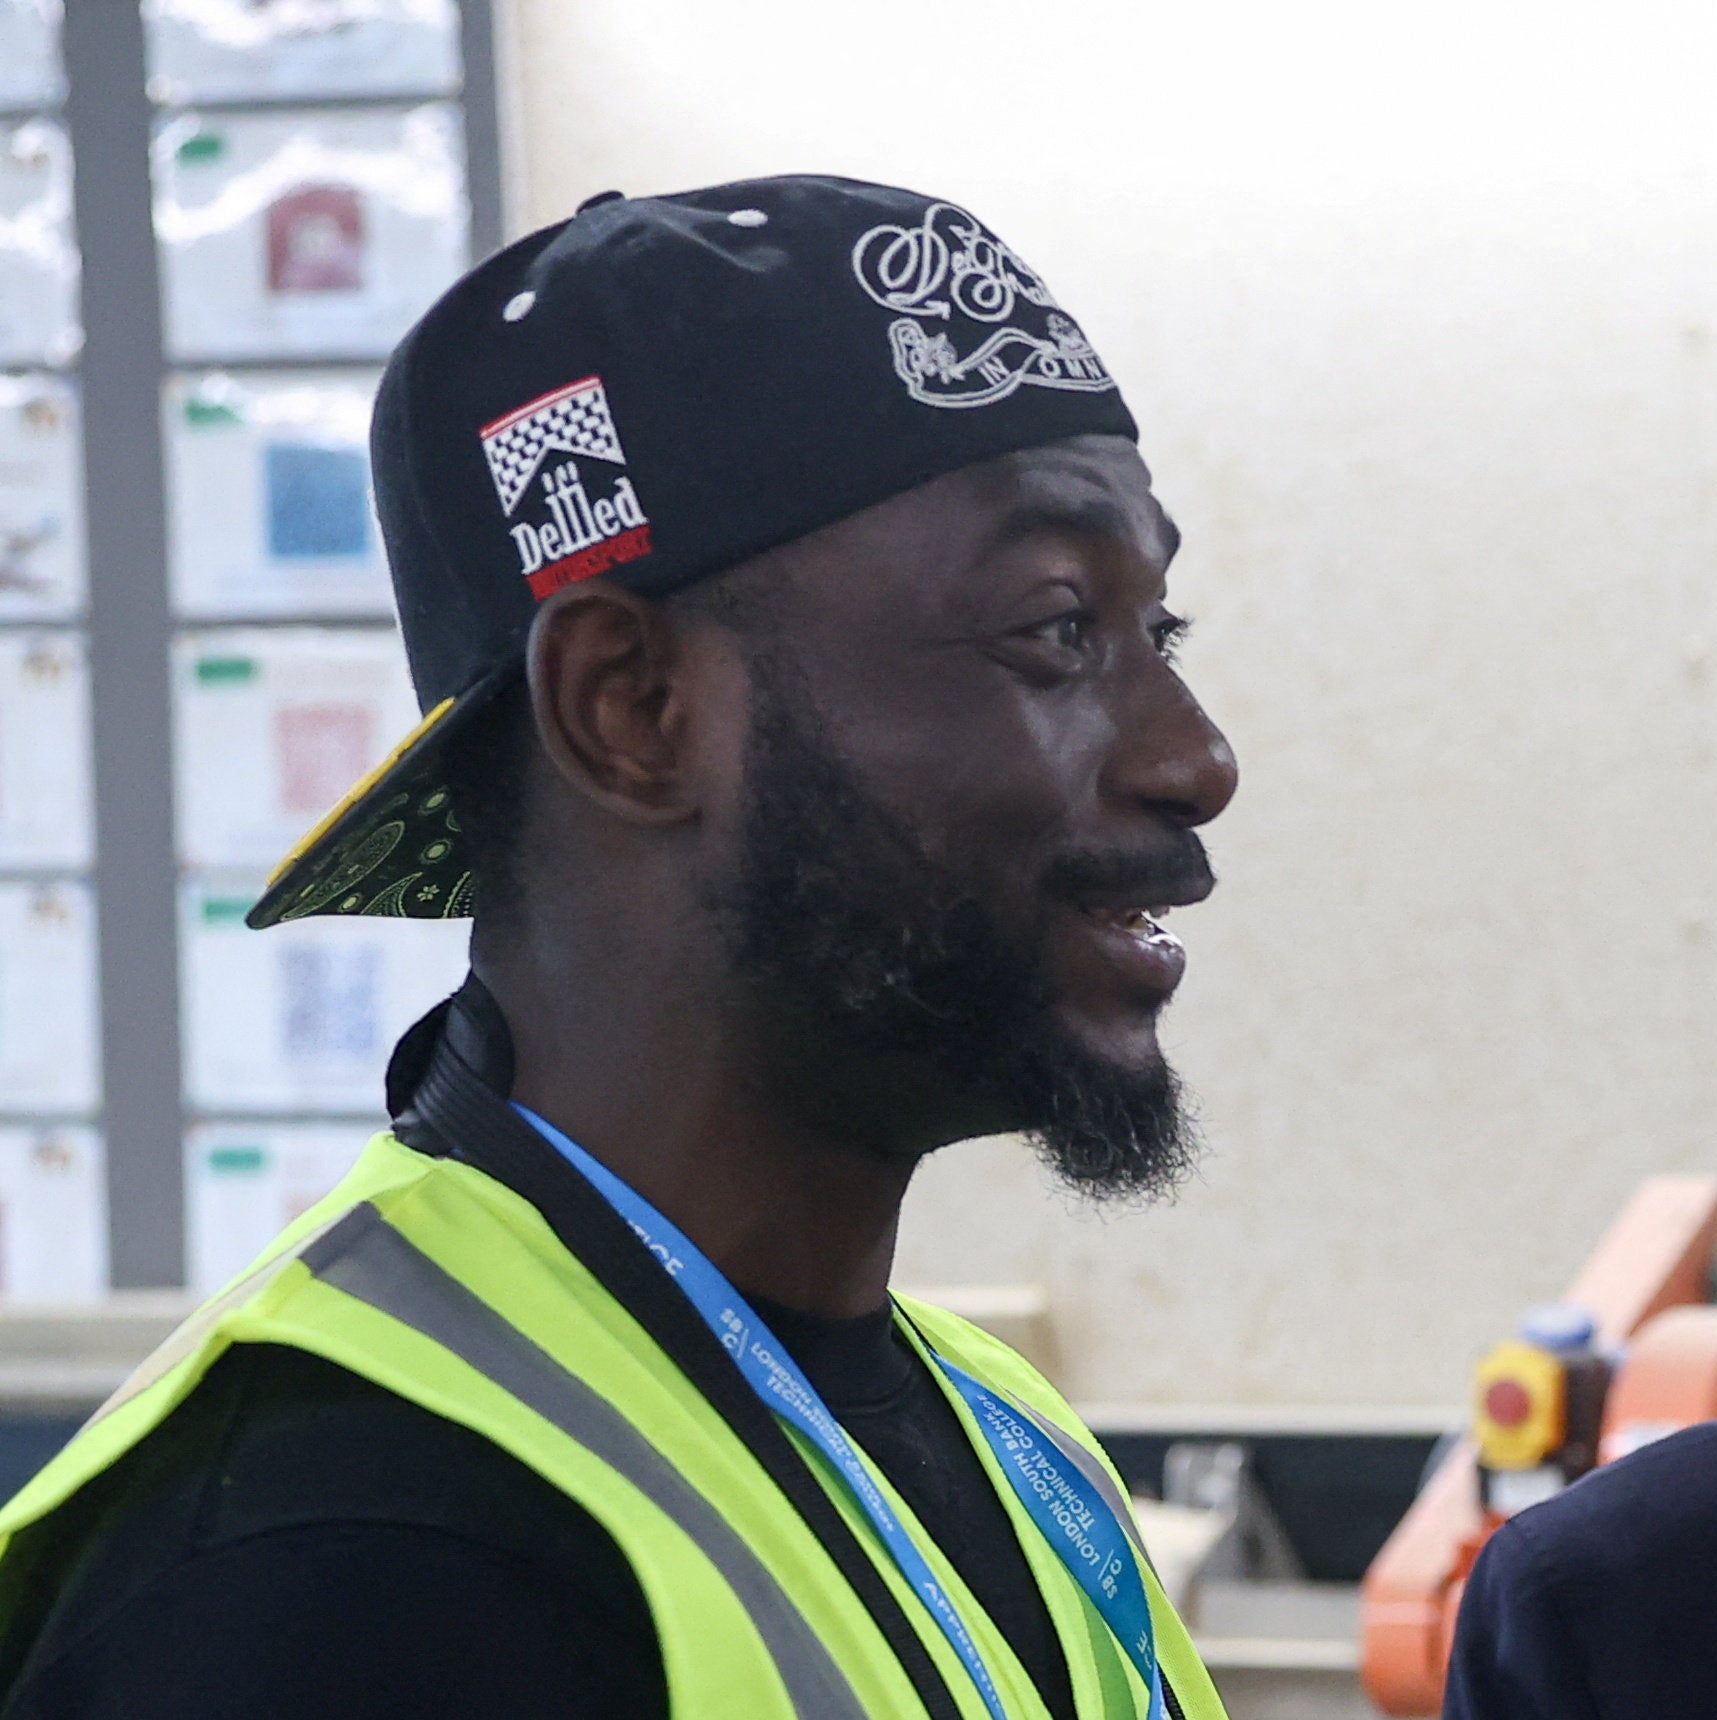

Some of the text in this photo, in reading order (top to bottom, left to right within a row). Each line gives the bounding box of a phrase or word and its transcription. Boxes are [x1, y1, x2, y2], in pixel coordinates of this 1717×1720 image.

[976, 1394, 1095, 1532] TECHNICAL COLLEGE
[983, 1412, 1101, 1567] LONDON SOUTH BANK
[1102, 1574, 1118, 1600] SB
[1110, 1558, 1122, 1575] C
